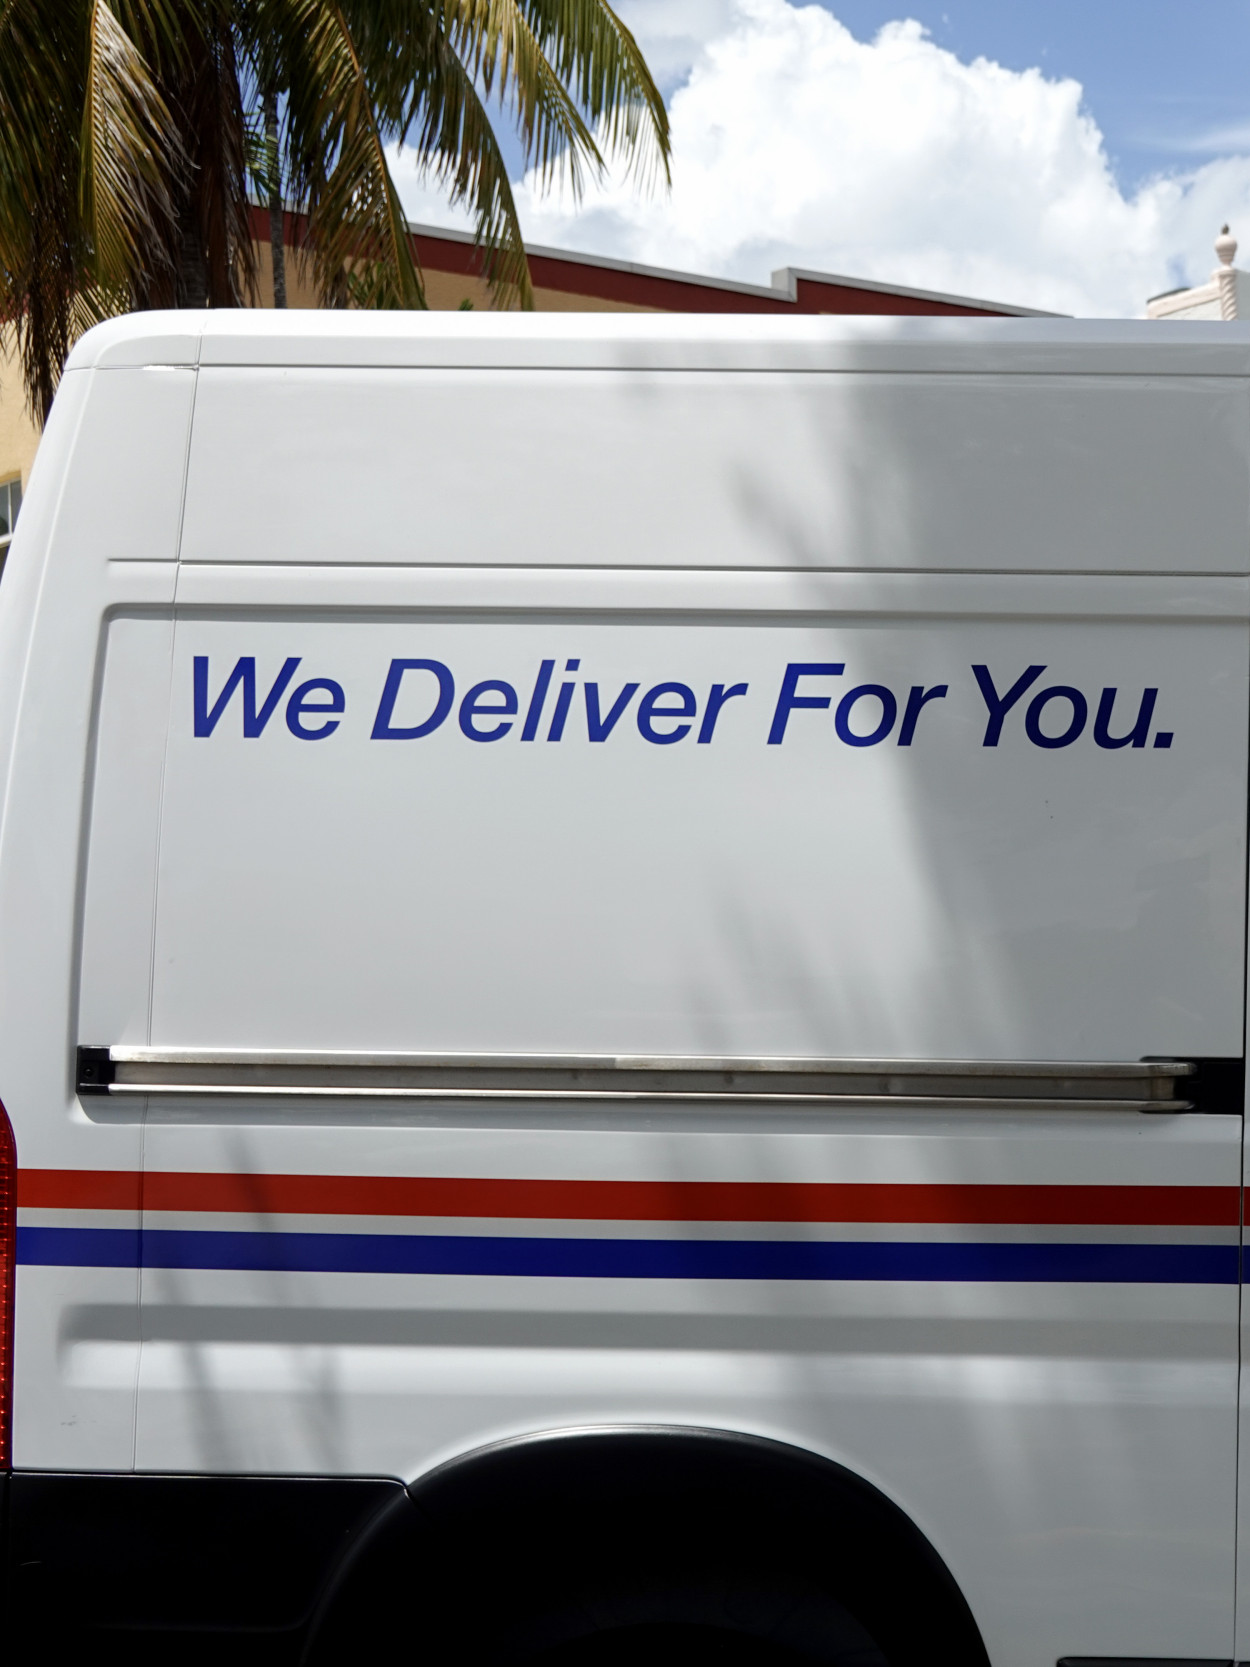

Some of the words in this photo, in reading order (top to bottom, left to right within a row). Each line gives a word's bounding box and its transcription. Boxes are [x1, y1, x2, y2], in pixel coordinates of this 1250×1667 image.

[193, 656, 345, 741] We
[370, 659, 749, 745] Deliver
[767, 663, 948, 748] For
[971, 664, 1174, 749] You.
